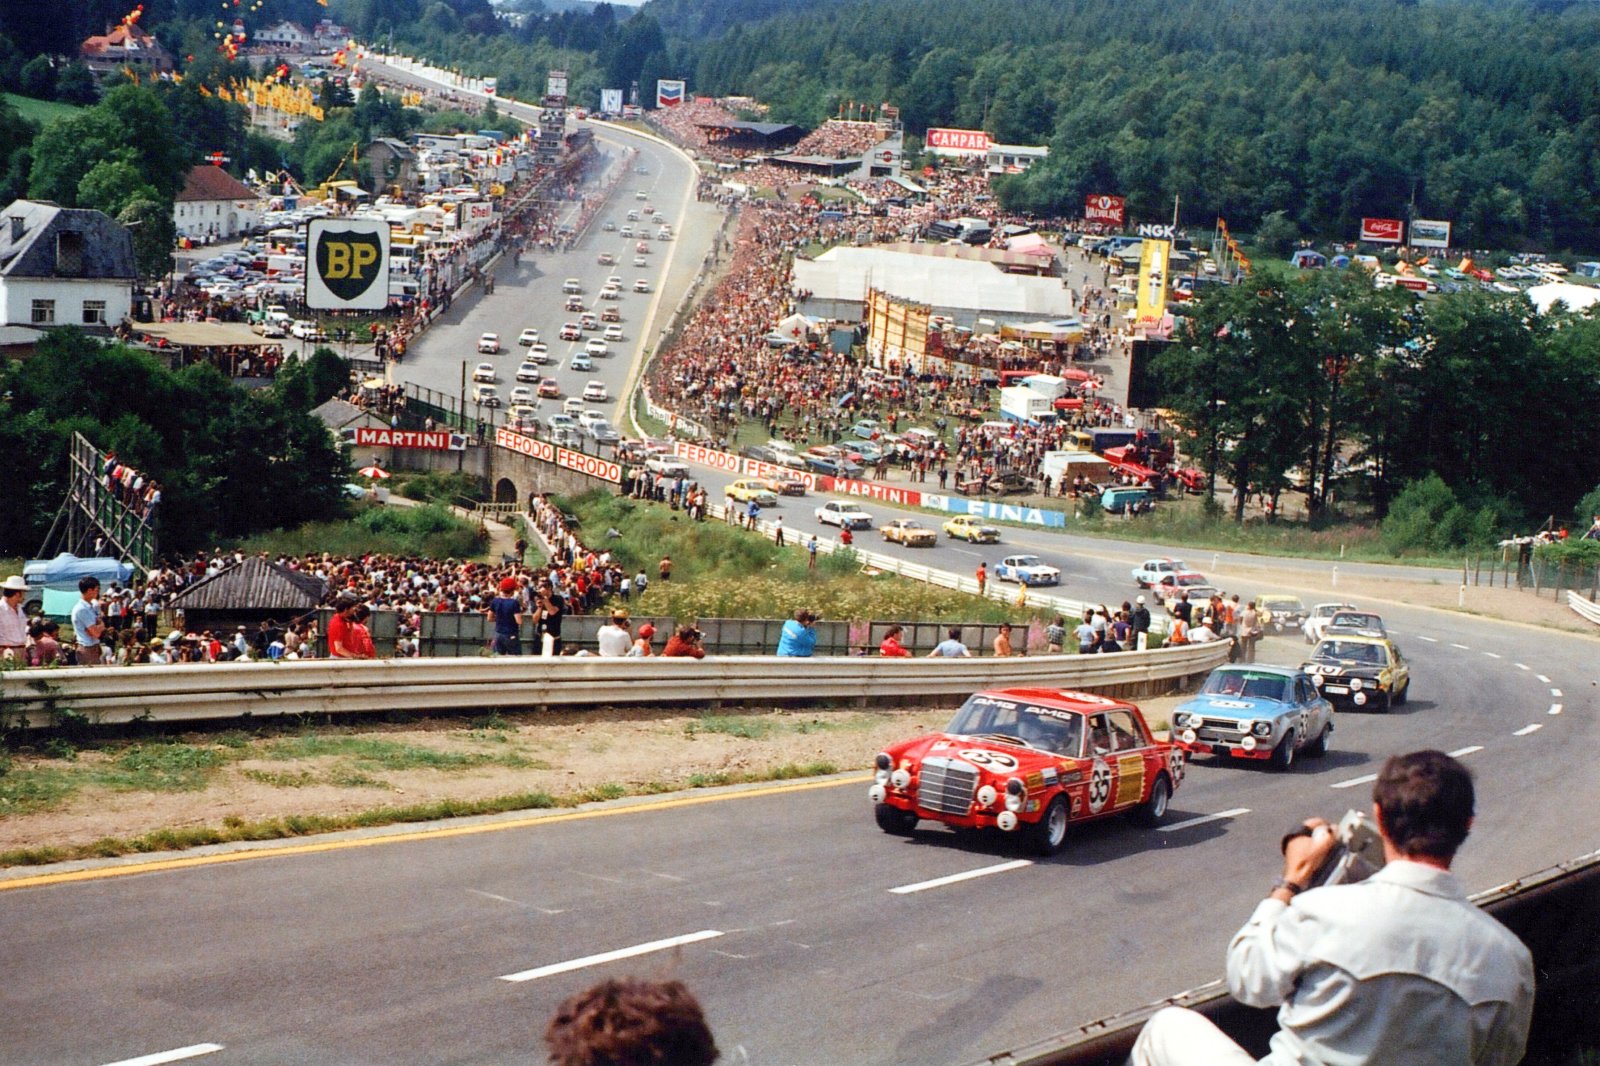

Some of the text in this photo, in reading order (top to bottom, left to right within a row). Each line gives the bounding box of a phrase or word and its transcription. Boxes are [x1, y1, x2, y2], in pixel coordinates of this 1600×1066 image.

[471, 205, 492, 219] Shell
[1085, 206, 1123, 222] VALVOLINE
[1139, 223, 1175, 238] NGK
[324, 242, 378, 279] BP
[649, 405, 671, 426] Shell
[676, 418, 699, 437] Shell
[361, 430, 444, 447] MARTINI
[497, 430, 552, 460] FERODO
[558, 449, 619, 481] FERODO
[677, 444, 737, 470] FERODO
[747, 460, 813, 489] FEDO
[834, 479, 908, 505] MARTINI
[967, 500, 1045, 525] FINA
[973, 698, 1017, 710] AMG
[1025, 706, 1073, 720] AMG
[962, 751, 1015, 767] 35
[1091, 769, 1110, 804] 35
